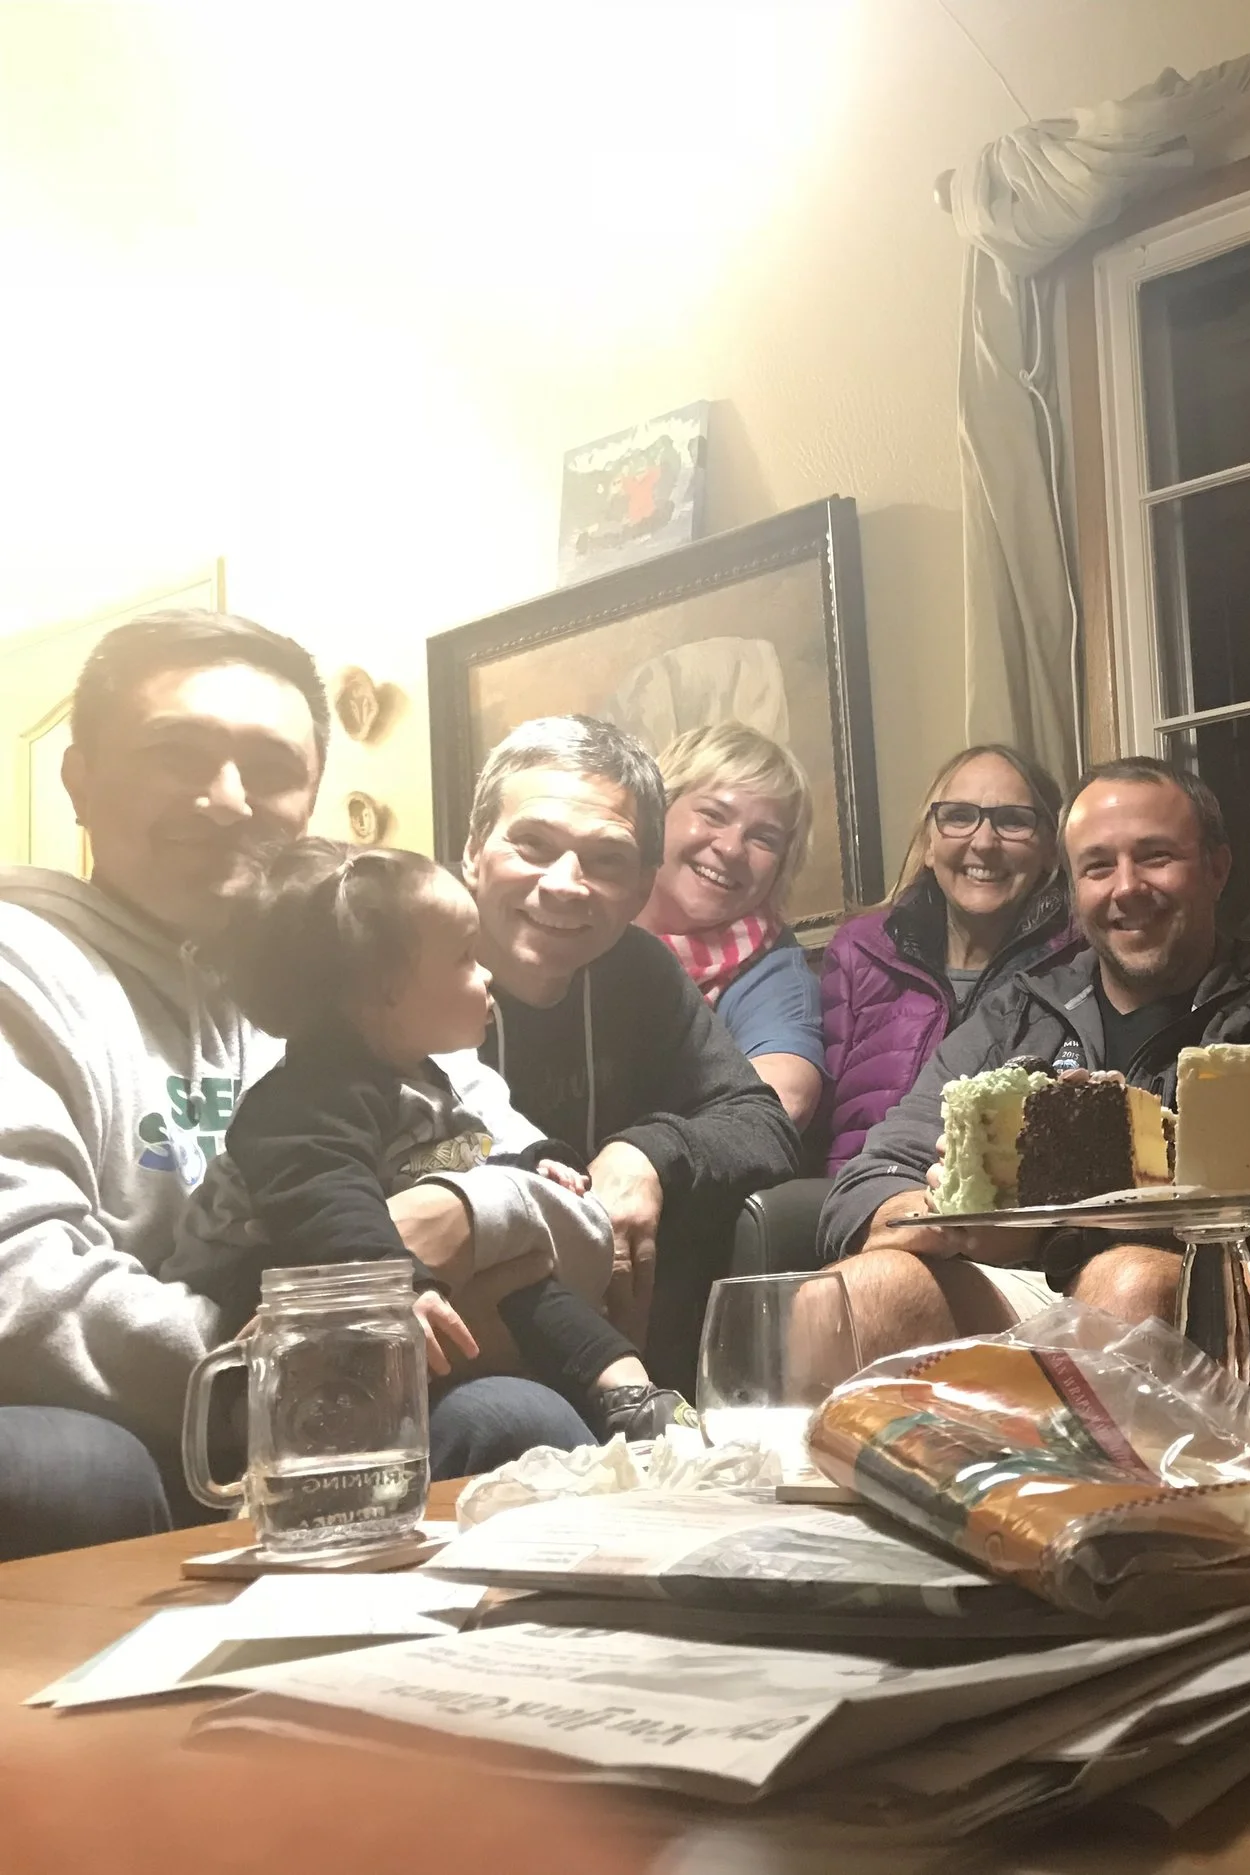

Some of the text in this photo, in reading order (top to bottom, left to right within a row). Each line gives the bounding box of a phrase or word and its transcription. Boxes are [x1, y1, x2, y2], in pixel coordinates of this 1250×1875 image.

[1062, 1051, 1080, 1060] 2015
[166, 1076, 242, 1131] SE
[496, 1704, 636, 1732] York
